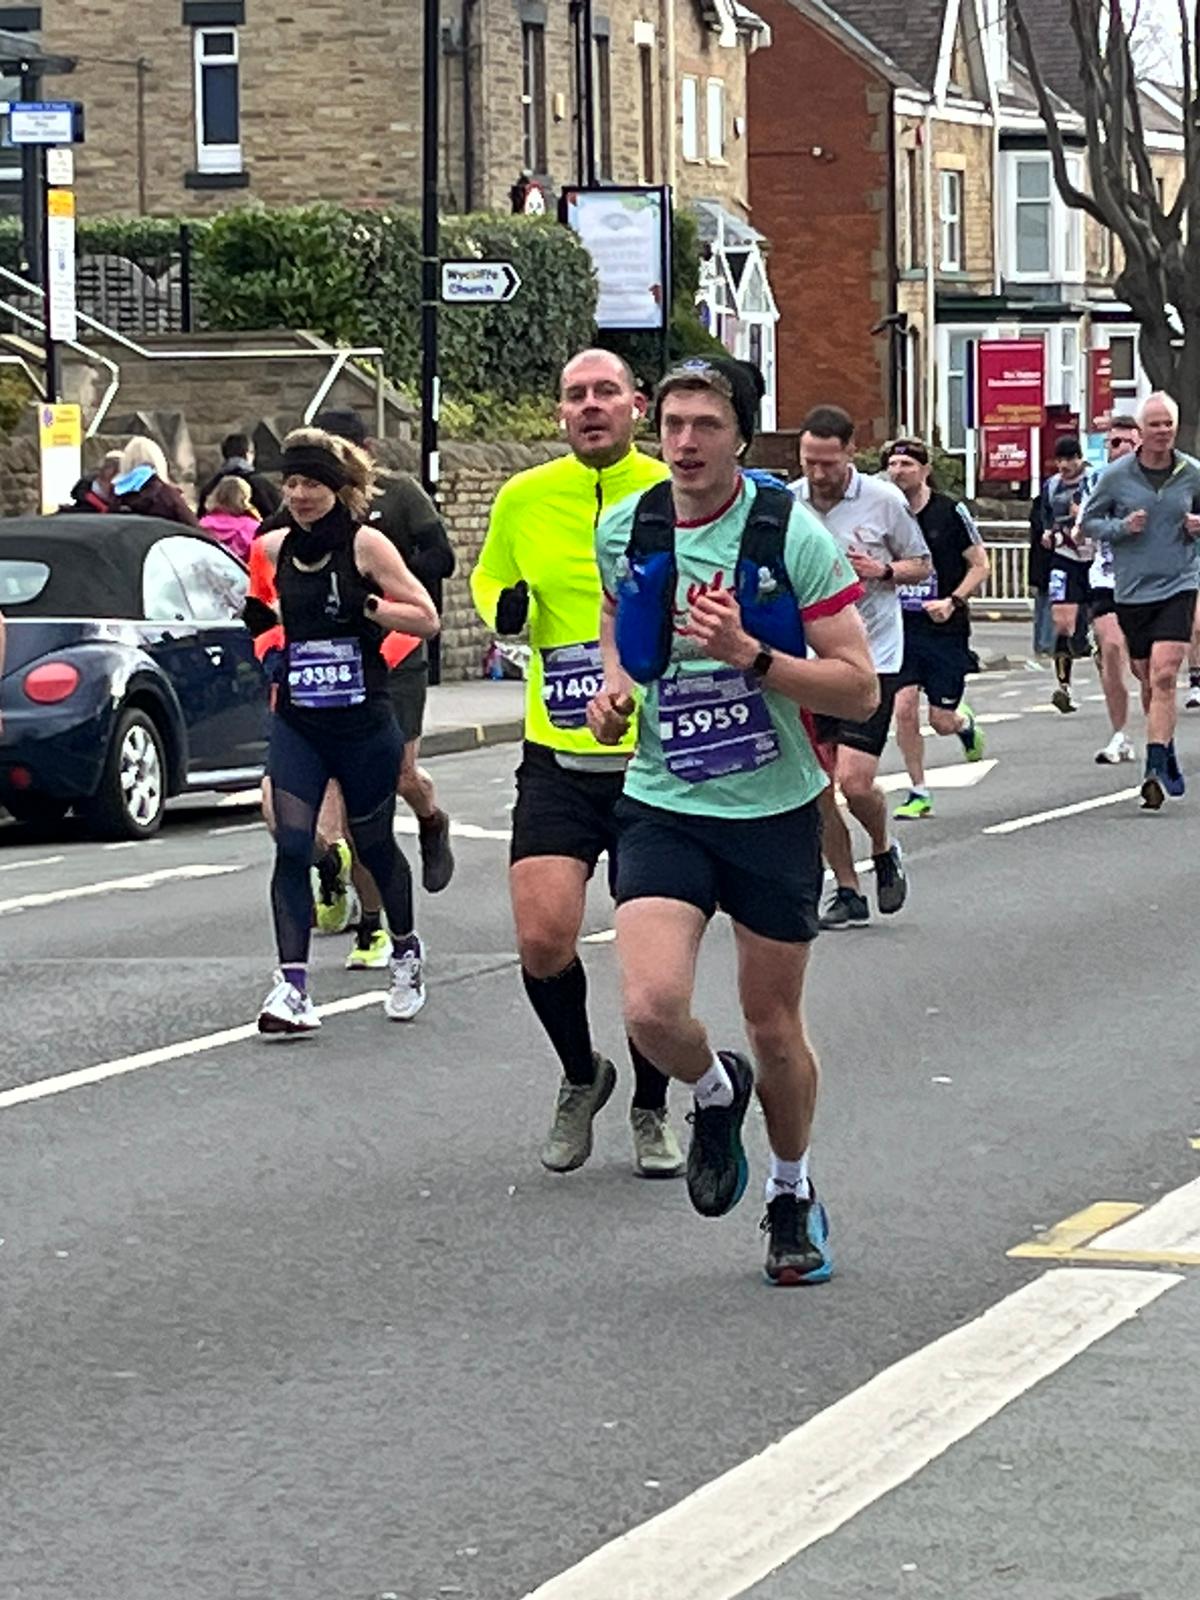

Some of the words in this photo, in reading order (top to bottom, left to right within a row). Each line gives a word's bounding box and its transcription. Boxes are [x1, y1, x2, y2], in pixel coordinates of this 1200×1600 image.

[446, 269, 498, 281] Wycliffe
[448, 283, 494, 295] Church
[677, 703, 749, 737] 5959
